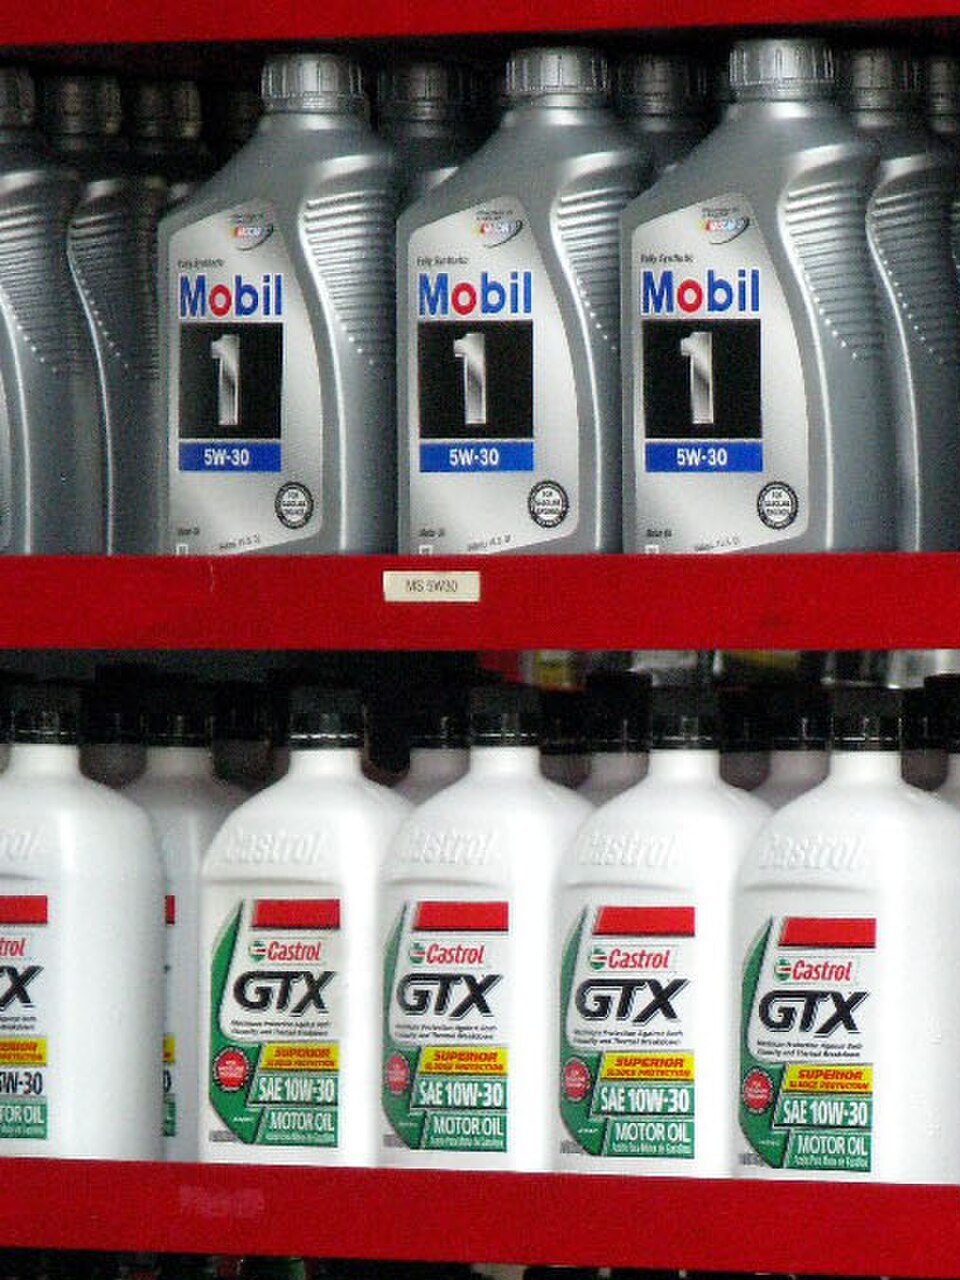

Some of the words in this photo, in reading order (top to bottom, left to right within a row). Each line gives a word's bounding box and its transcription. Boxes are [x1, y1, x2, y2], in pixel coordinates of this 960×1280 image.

[179, 273, 283, 317] Mobil
[418, 271, 532, 315] Mobil
[642, 269, 759, 313] Mobil
[211, 334, 240, 425] 1
[454, 333, 486, 424] 1
[680, 331, 714, 423] 1
[204, 449, 249, 466] 5W-30
[449, 448, 499, 466] 5W-30
[677, 448, 727, 466] 5W-30
[268, 941, 322, 962] Castrol
[426, 944, 485, 965] Castrol
[608, 948, 670, 969] Castrol
[792, 961, 852, 982] Castrol
[233, 970, 338, 1016] GTX
[397, 973, 502, 1019] GTX
[575, 978, 691, 1026] GTX
[758, 990, 871, 1038] GTX
[258, 1076, 283, 1101] SAE
[286, 1077, 335, 1103] 10W-30
[420, 1080, 444, 1105] SAE
[448, 1081, 502, 1107] 10W-30
[601, 1087, 626, 1112] SAE
[629, 1089, 690, 1113] 10W-30
[434, 1115, 480, 1136] MOTOR
[482, 1115, 503, 1136] OIL
[783, 1100, 807, 1124] SAE
[810, 1101, 868, 1126] 10W-30
[615, 1121, 666, 1142] MOTOR
[668, 1121, 691, 1142] OIL
[798, 1135, 846, 1155] MOTOR
[847, 1136, 868, 1156] OIL
